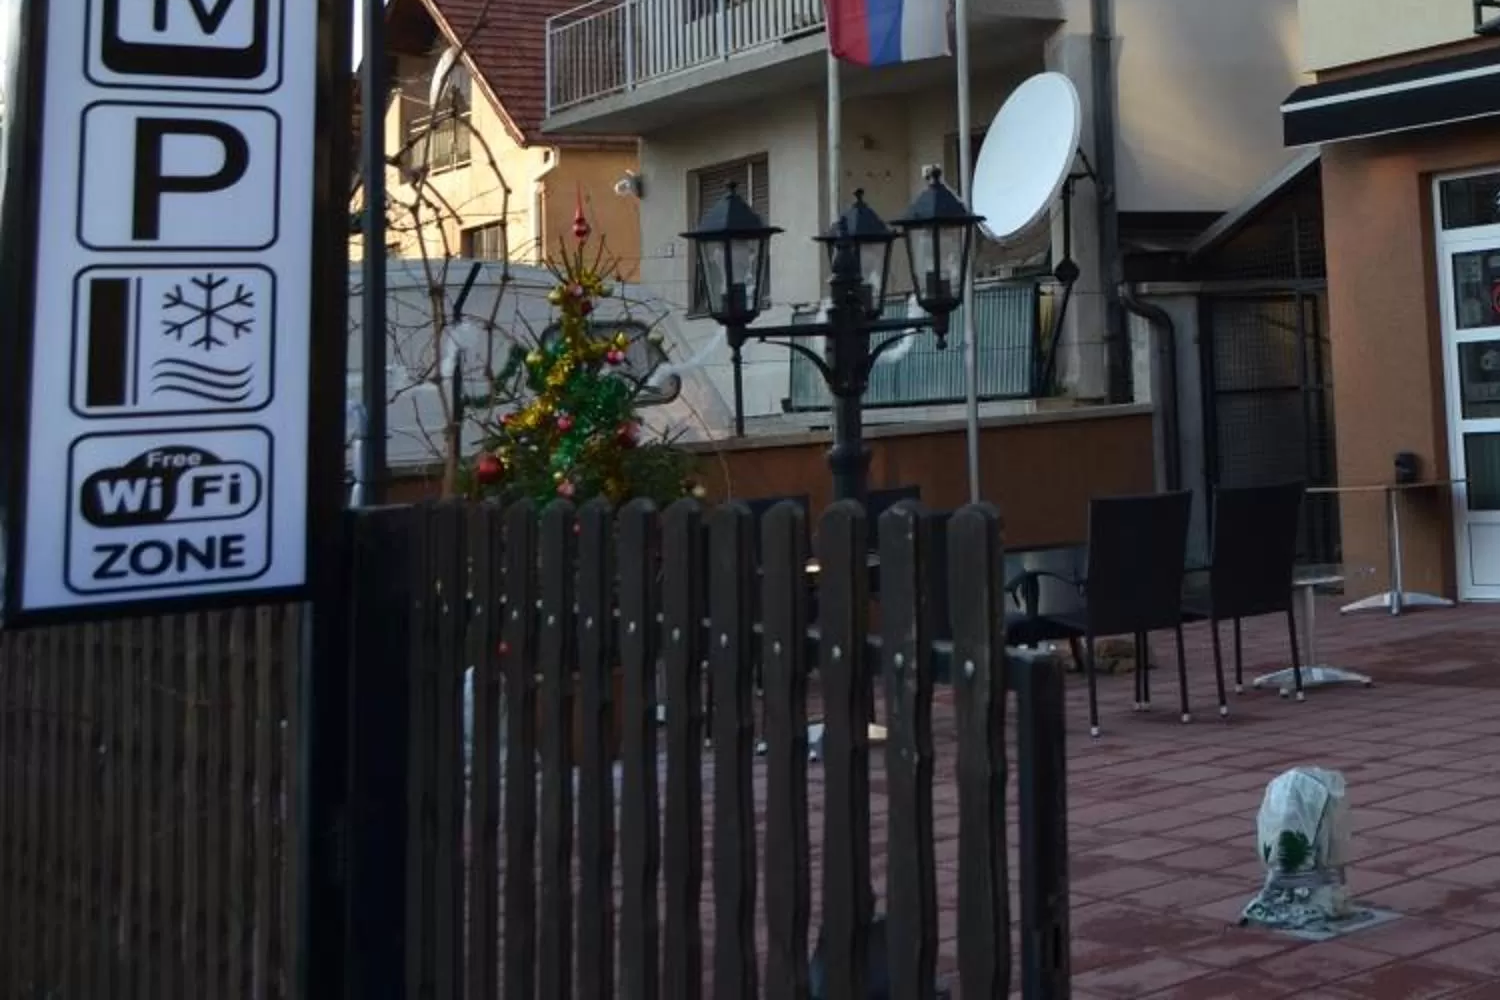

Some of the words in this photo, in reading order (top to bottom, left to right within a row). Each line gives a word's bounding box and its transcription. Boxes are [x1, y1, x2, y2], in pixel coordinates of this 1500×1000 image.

[131, 116, 250, 242] P
[148, 452, 202, 468] Free
[92, 533, 246, 580] ZONE
